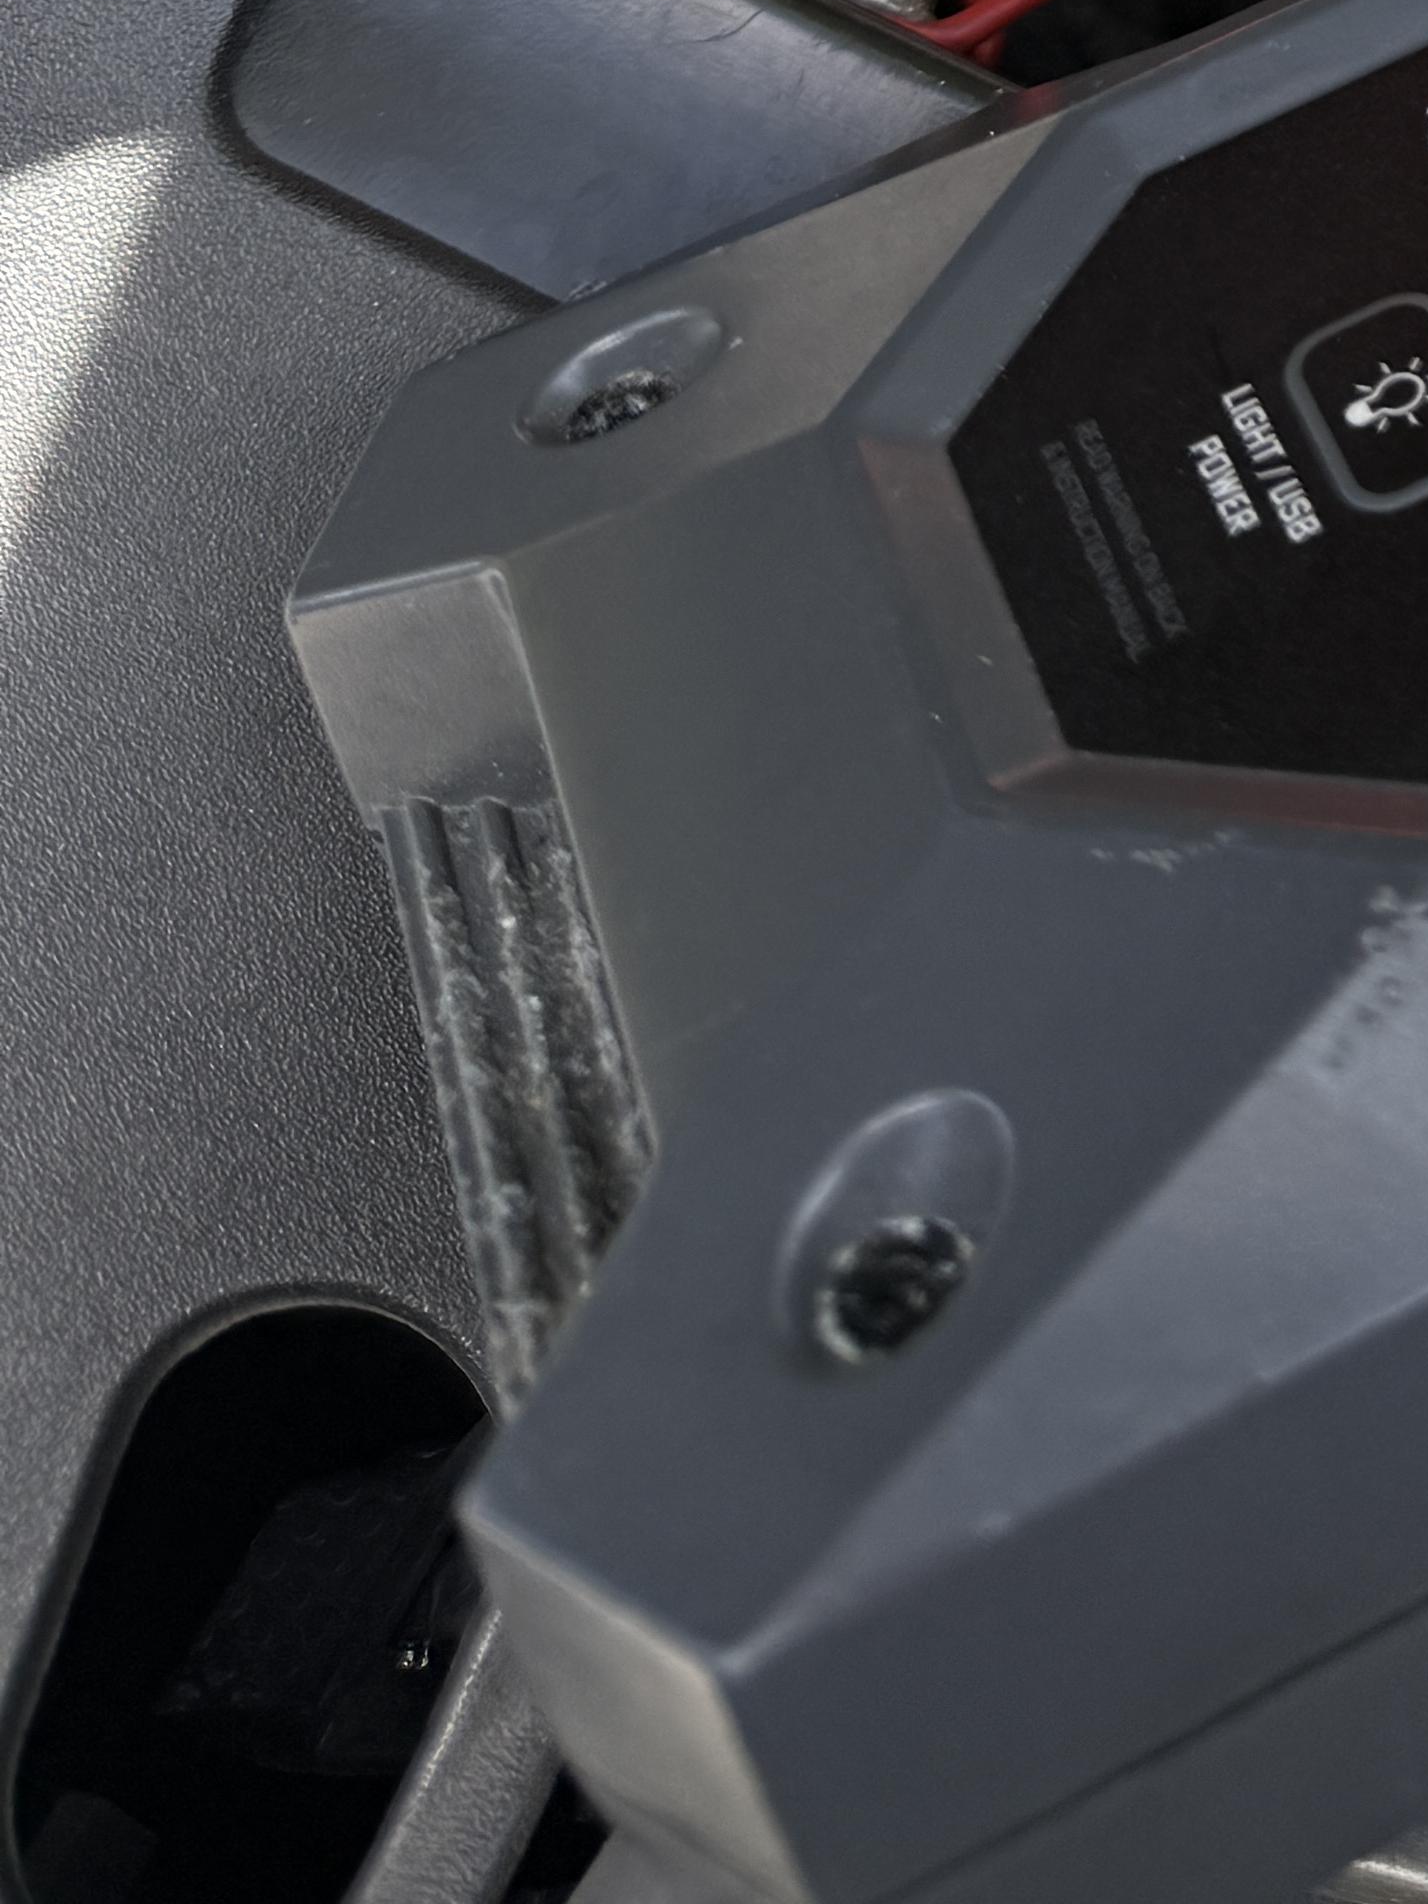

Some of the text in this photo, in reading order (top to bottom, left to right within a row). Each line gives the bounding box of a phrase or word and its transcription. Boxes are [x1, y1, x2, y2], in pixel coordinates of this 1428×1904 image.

[1187, 433, 1261, 537] POWER
[1221, 382, 1287, 463] LIGHT
[1267, 477, 1324, 543] USB
